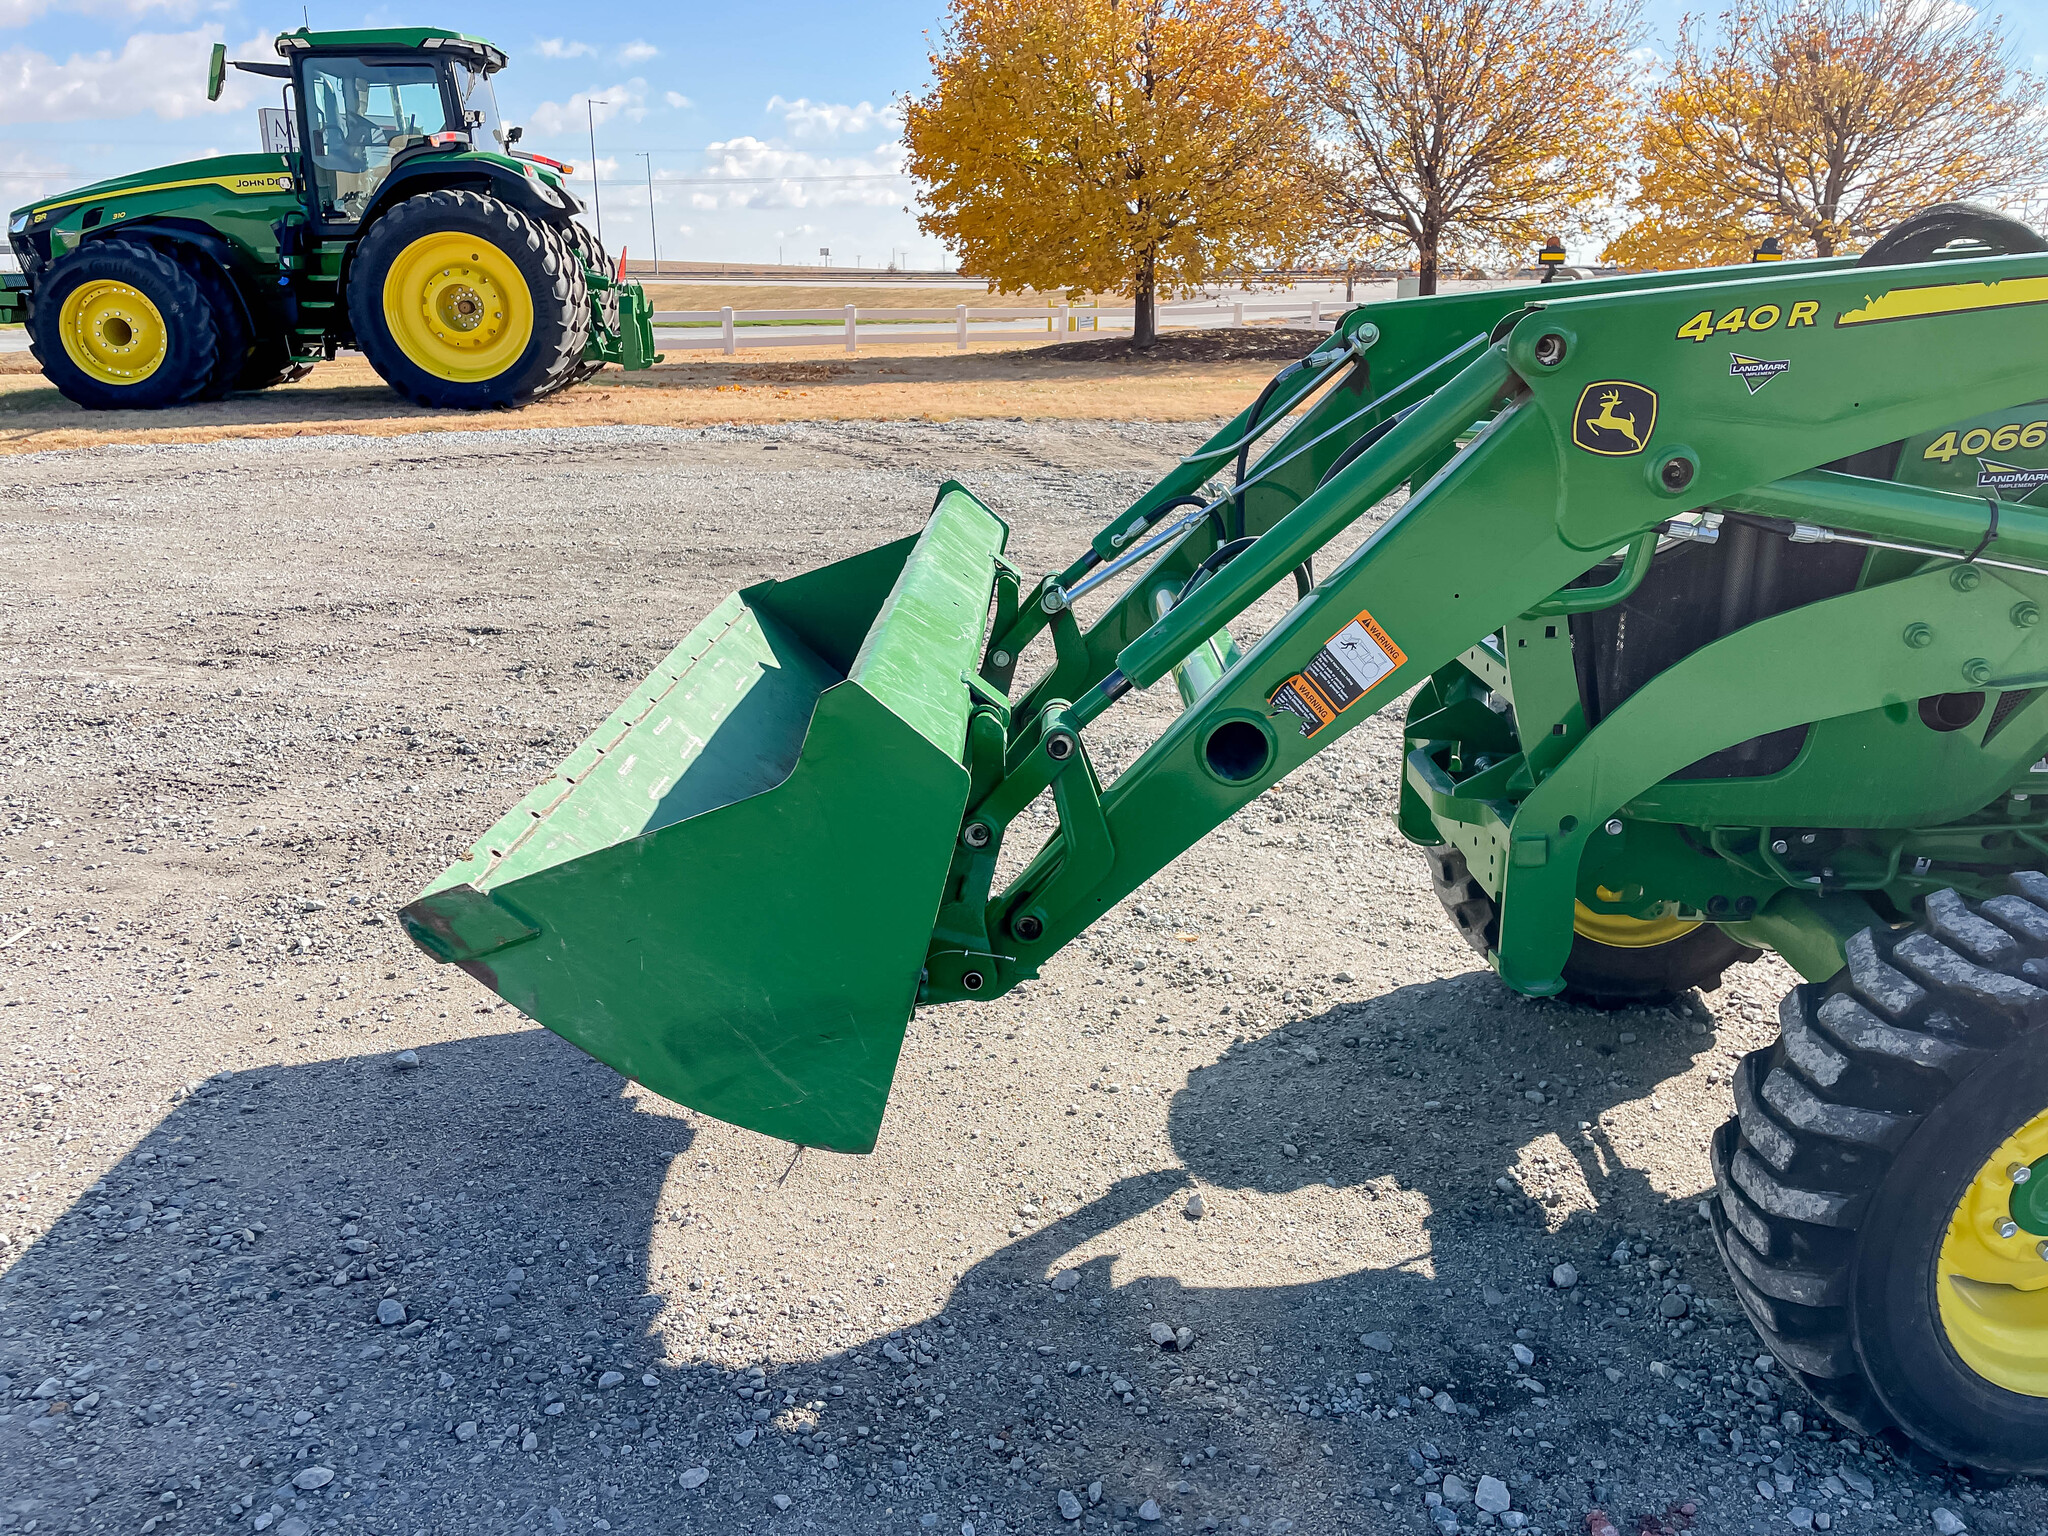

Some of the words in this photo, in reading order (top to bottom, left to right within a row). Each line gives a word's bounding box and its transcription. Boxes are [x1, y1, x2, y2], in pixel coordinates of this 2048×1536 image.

[236, 179, 265, 188] JOHN
[34, 212, 48, 224] 8R
[112, 211, 127, 220] 310
[1676, 303, 1782, 343] 440
[1786, 300, 1820, 328] R
[1922, 420, 2048, 463] 4066
[1997, 481, 2037, 489] IMPLEMENT
[1370, 625, 1400, 660] WARNING
[1298, 684, 1328, 719] WARNING
